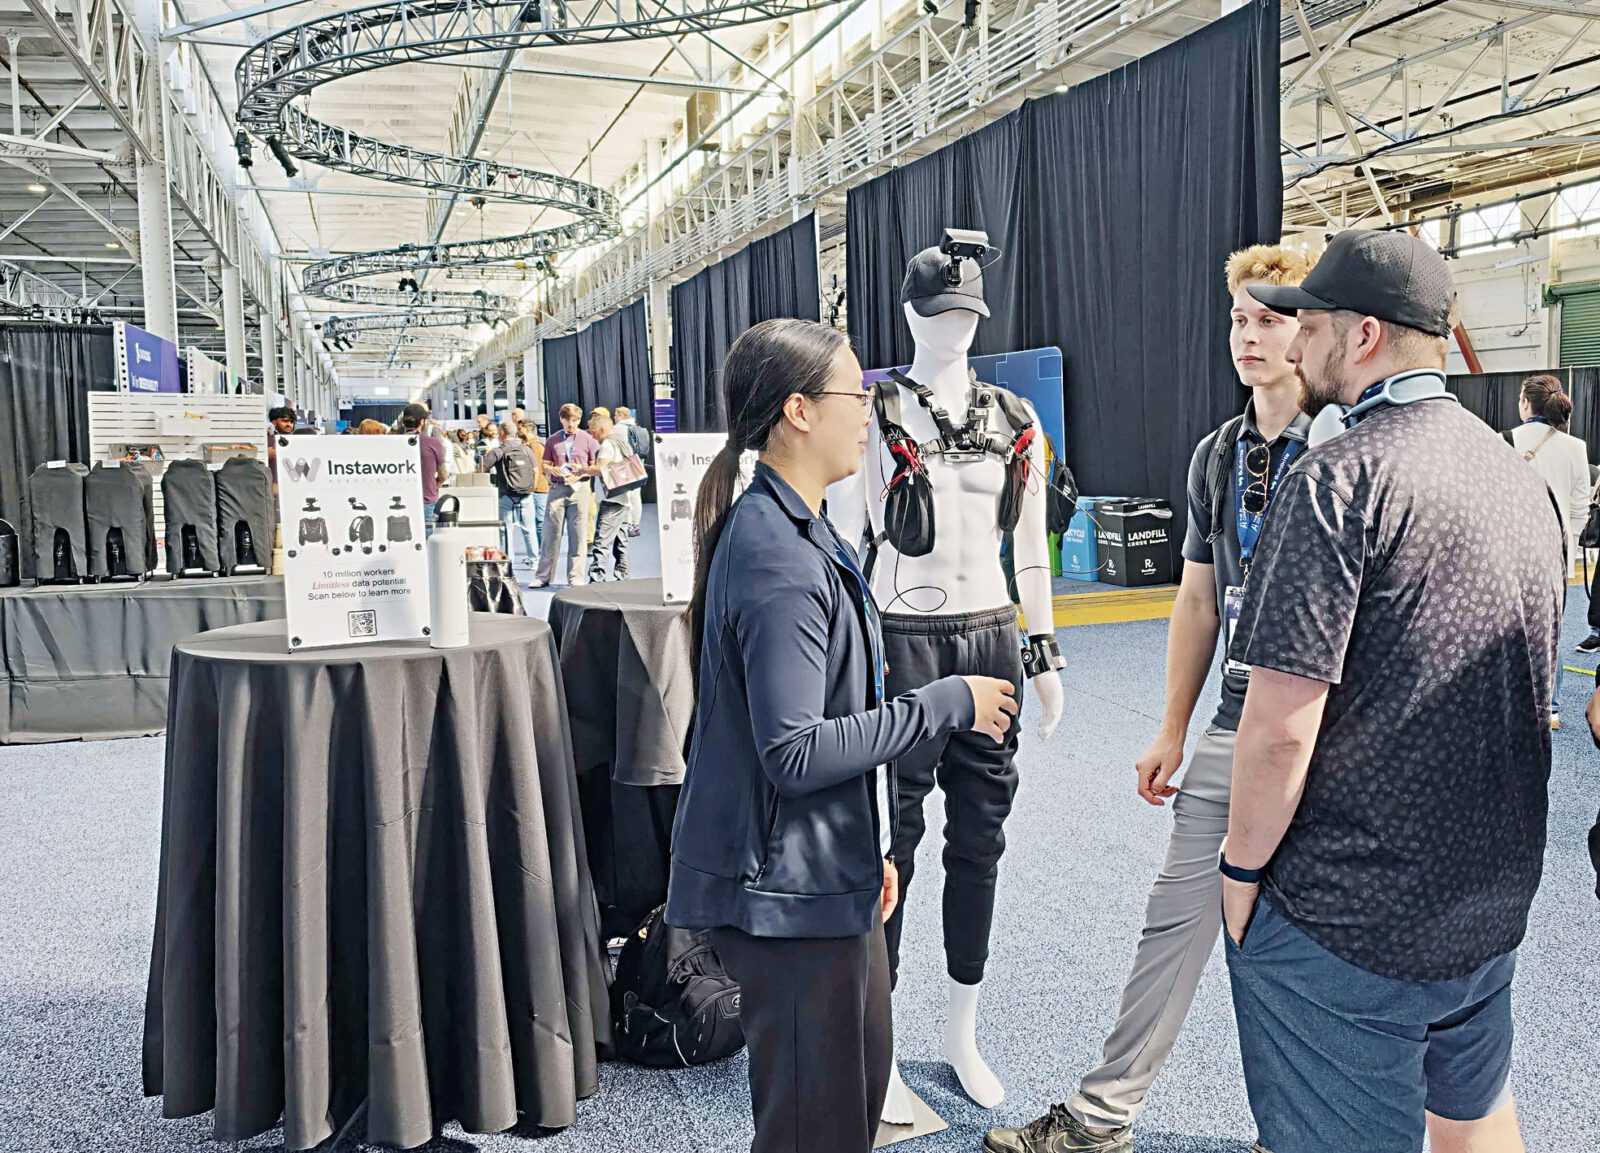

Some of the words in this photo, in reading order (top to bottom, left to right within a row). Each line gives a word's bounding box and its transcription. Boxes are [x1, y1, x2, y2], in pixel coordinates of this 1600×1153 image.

[327, 459, 417, 475] Instawork
[1066, 528, 1085, 538] ECYCLE
[1127, 528, 1167, 541] LANDFILL
[323, 571, 333, 579] 10
[335, 569, 361, 577] million
[363, 568, 395, 577] workers
[312, 581, 350, 590] Limitless
[352, 579, 370, 587] data
[372, 577, 406, 587] potential
[308, 592, 329, 600] Scan
[331, 591, 356, 599] below
[368, 588, 389, 597] learn
